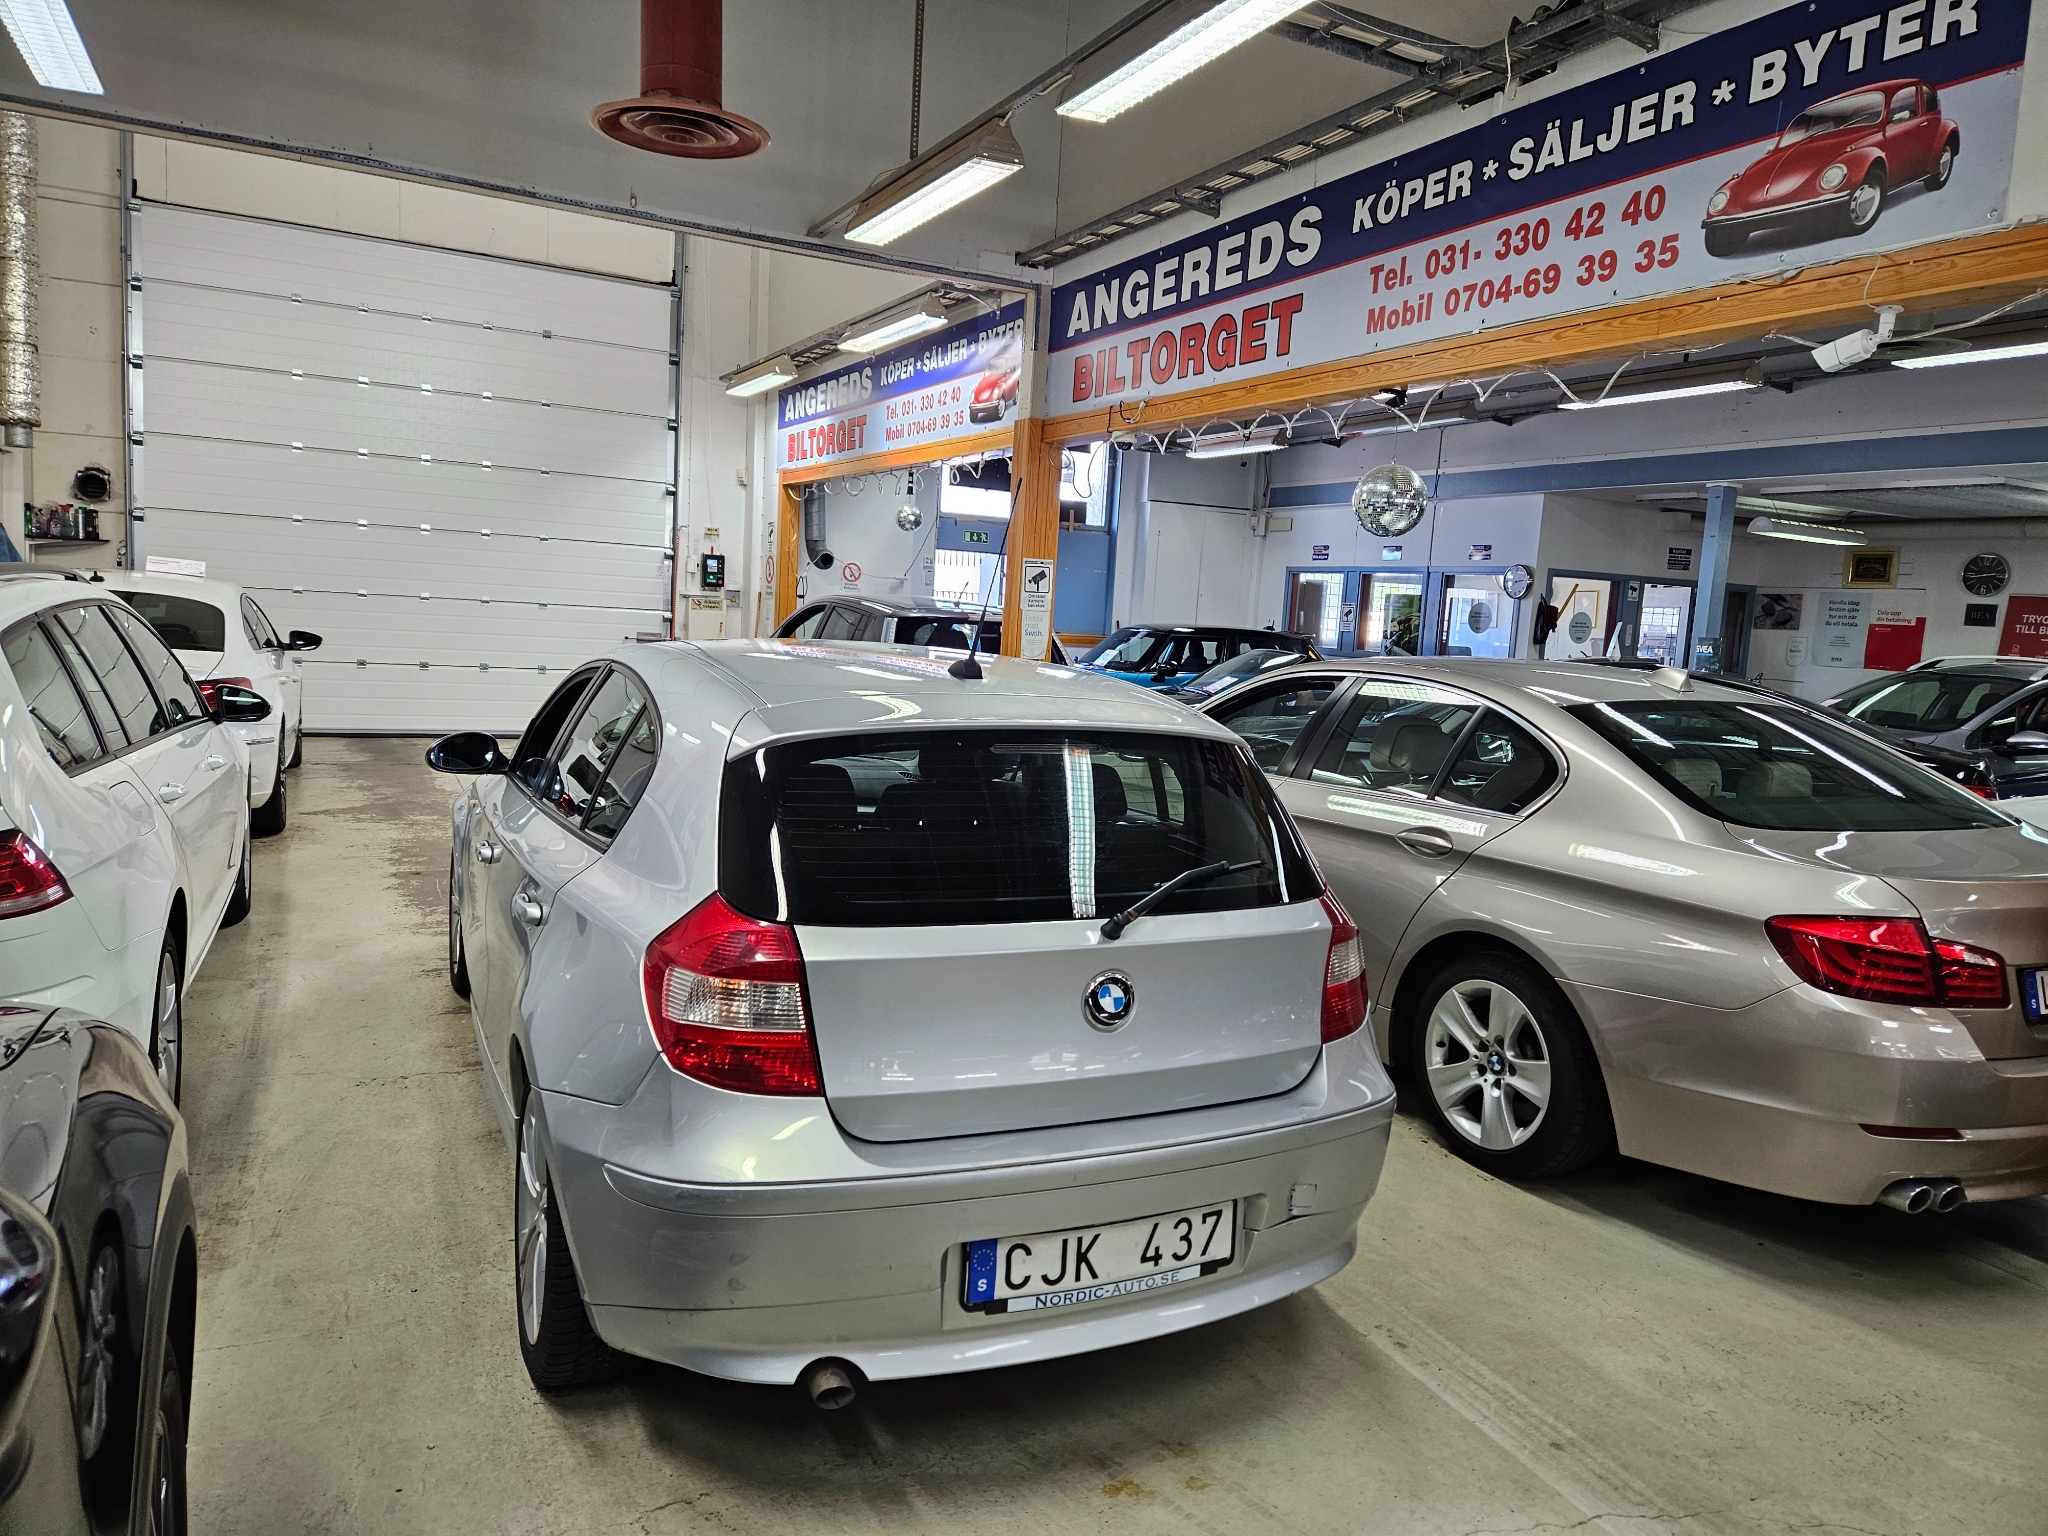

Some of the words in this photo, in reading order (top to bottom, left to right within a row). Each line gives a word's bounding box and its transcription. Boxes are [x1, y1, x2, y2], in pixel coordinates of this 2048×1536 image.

[1352, 159, 1473, 233] KÖPER
[1508, 81, 1697, 181] SÄLJER
[1748, 0, 1978, 104] BYTER
[1369, 256, 1412, 294] Tel.
[1425, 239, 1481, 279] 031-
[1495, 218, 1550, 260] 330
[1564, 201, 1605, 241] 42
[1622, 184, 1666, 226] 40
[1066, 205, 1323, 338] ANGEREDS
[1366, 292, 1433, 334] Mobil
[1444, 263, 1561, 316] 0704-69
[1576, 250, 1617, 286] 39
[1634, 233, 1680, 273] 35
[880, 357, 915, 386] KÖPER
[922, 338, 967, 373] SÄLJER
[979, 318, 1024, 354] BYTER
[1072, 293, 1303, 402] BILTORGET
[785, 366, 872, 423] ANGEREDS
[886, 402, 899, 420] Tel.
[920, 394, 934, 412] 330
[937, 390, 947, 406] 42
[951, 386, 961, 402] 40
[788, 414, 867, 462] BILTORGET
[885, 424, 904, 441] Mobil
[907, 417, 937, 437] 0704-69
[940, 413, 950, 430] 39
[954, 410, 964, 426] 35
[1696, 645, 1713, 653] SVEA
[2015, 624, 2037, 634] TILL
[2031, 999, 2037, 1009] S
[1004, 1233, 1101, 1290] CJK
[1139, 1208, 1223, 1267] 437
[977, 1278, 987, 1291] S
[1035, 1271, 1180, 1309] NORDIC-AUTO.SE
